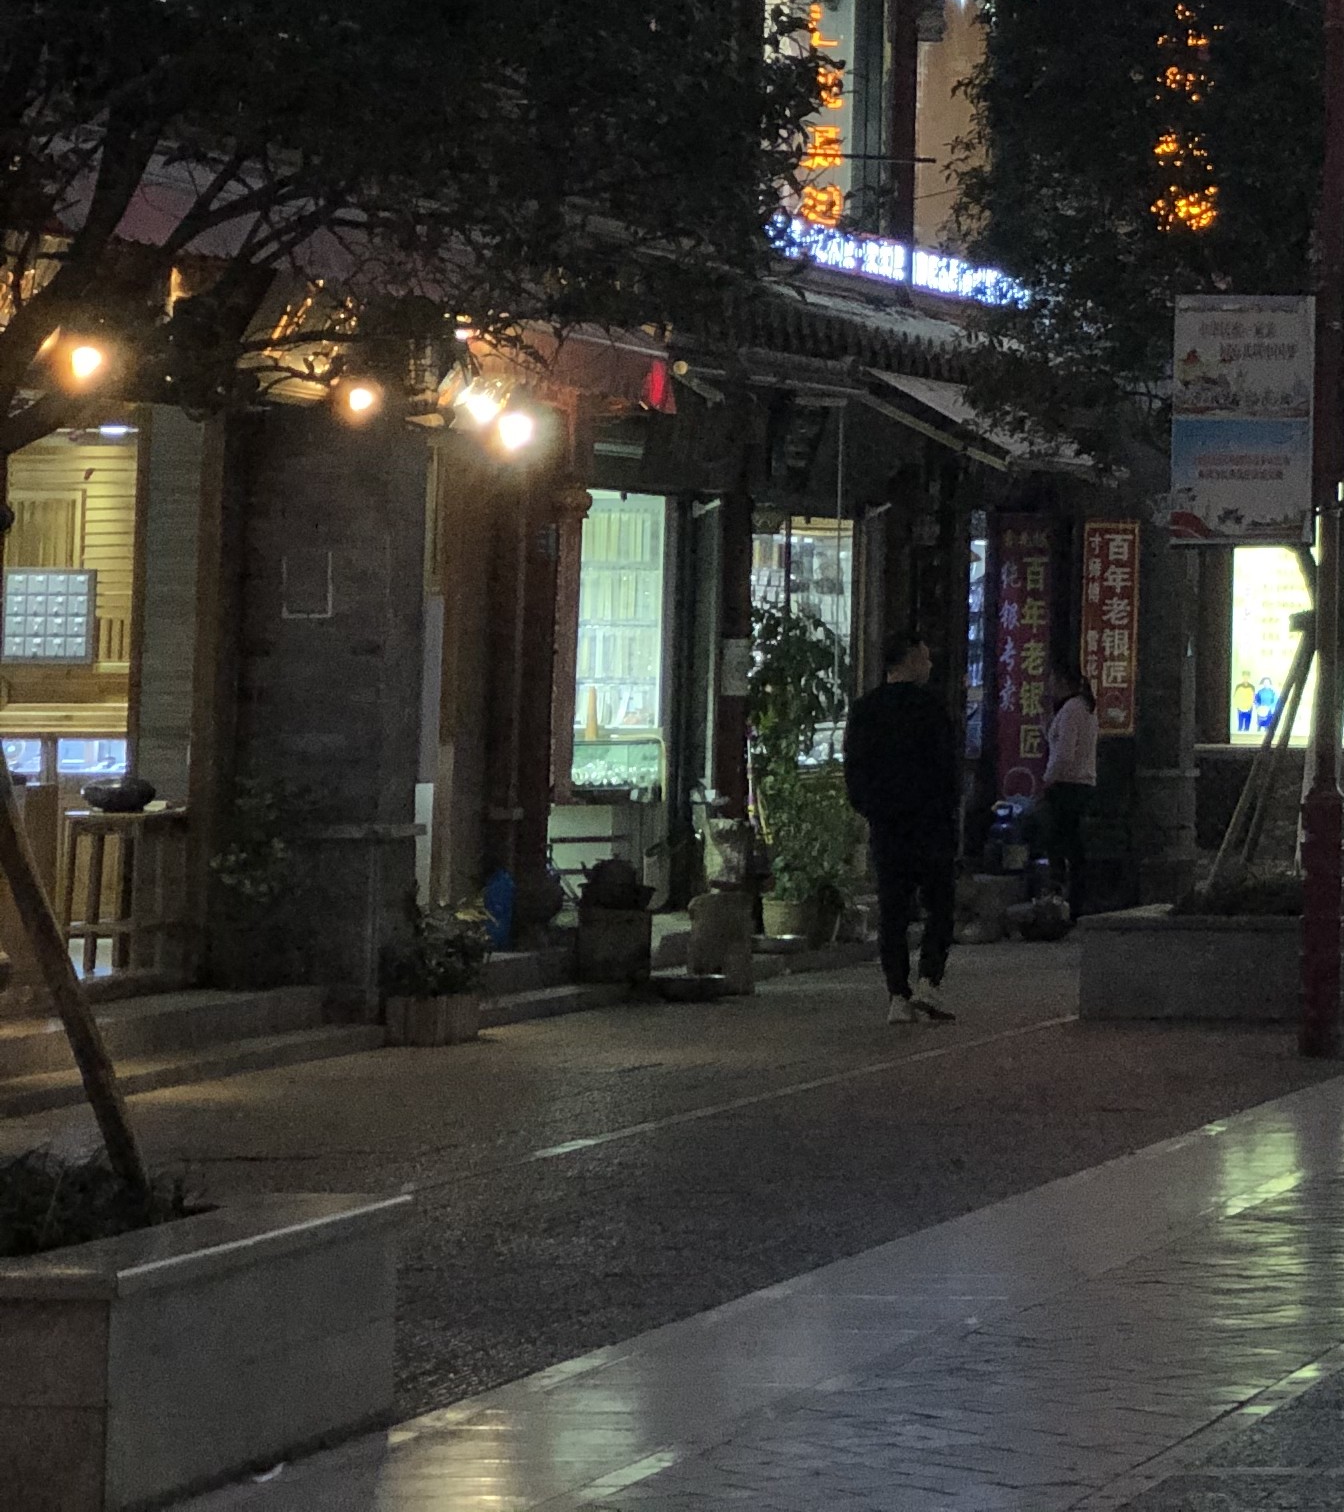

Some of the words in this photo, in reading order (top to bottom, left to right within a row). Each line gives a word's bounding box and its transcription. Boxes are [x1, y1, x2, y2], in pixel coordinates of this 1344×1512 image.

[1019, 556, 1049, 759] 百年老银匠
[1102, 534, 1134, 688] 百年老银匠
